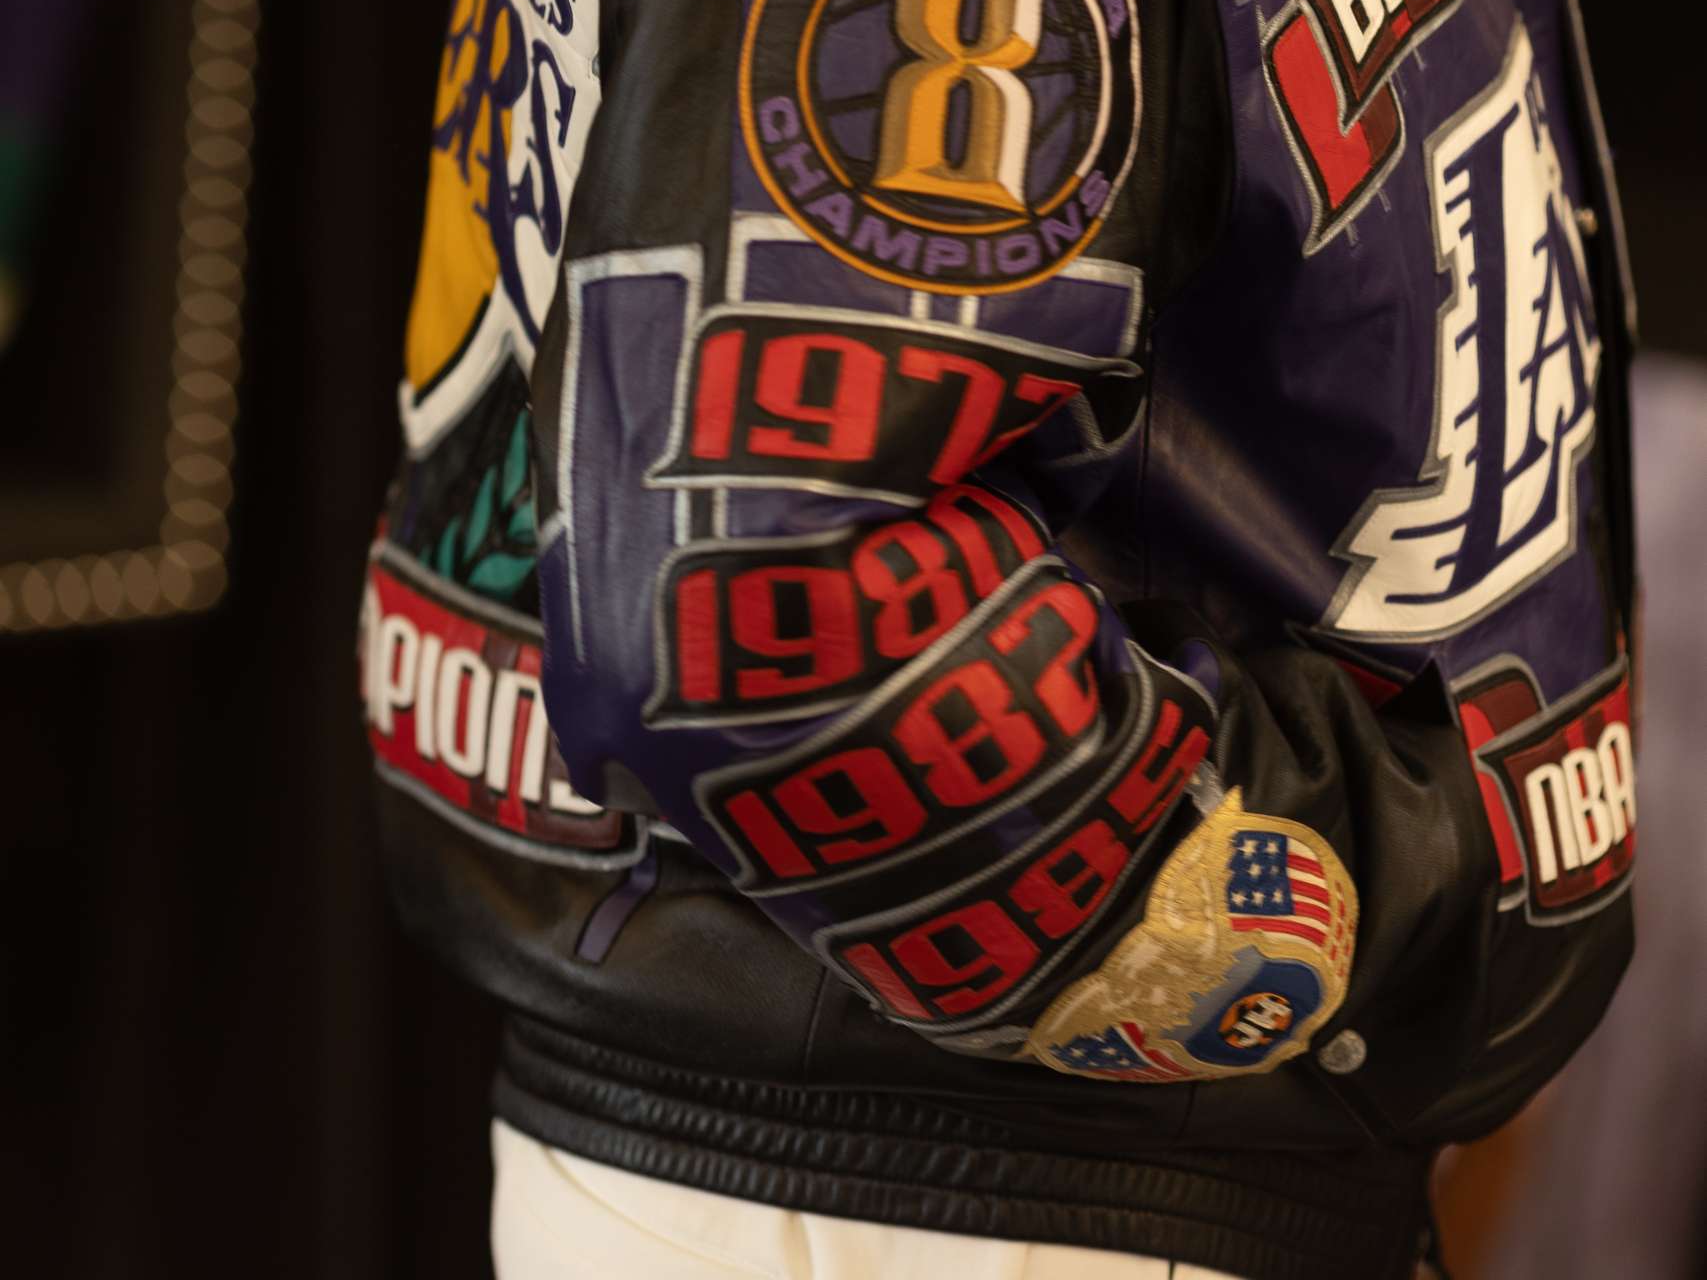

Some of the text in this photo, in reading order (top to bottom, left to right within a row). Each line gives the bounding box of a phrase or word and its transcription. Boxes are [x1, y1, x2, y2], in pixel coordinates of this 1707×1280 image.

[758, 95, 1111, 276] CHAMPIONS
[360, 582, 604, 815] PION
[676, 482, 1044, 703] 1980
[725, 582, 1099, 879] 1982
[1525, 719, 1637, 885] NBA
[843, 698, 1211, 1020] 1985
